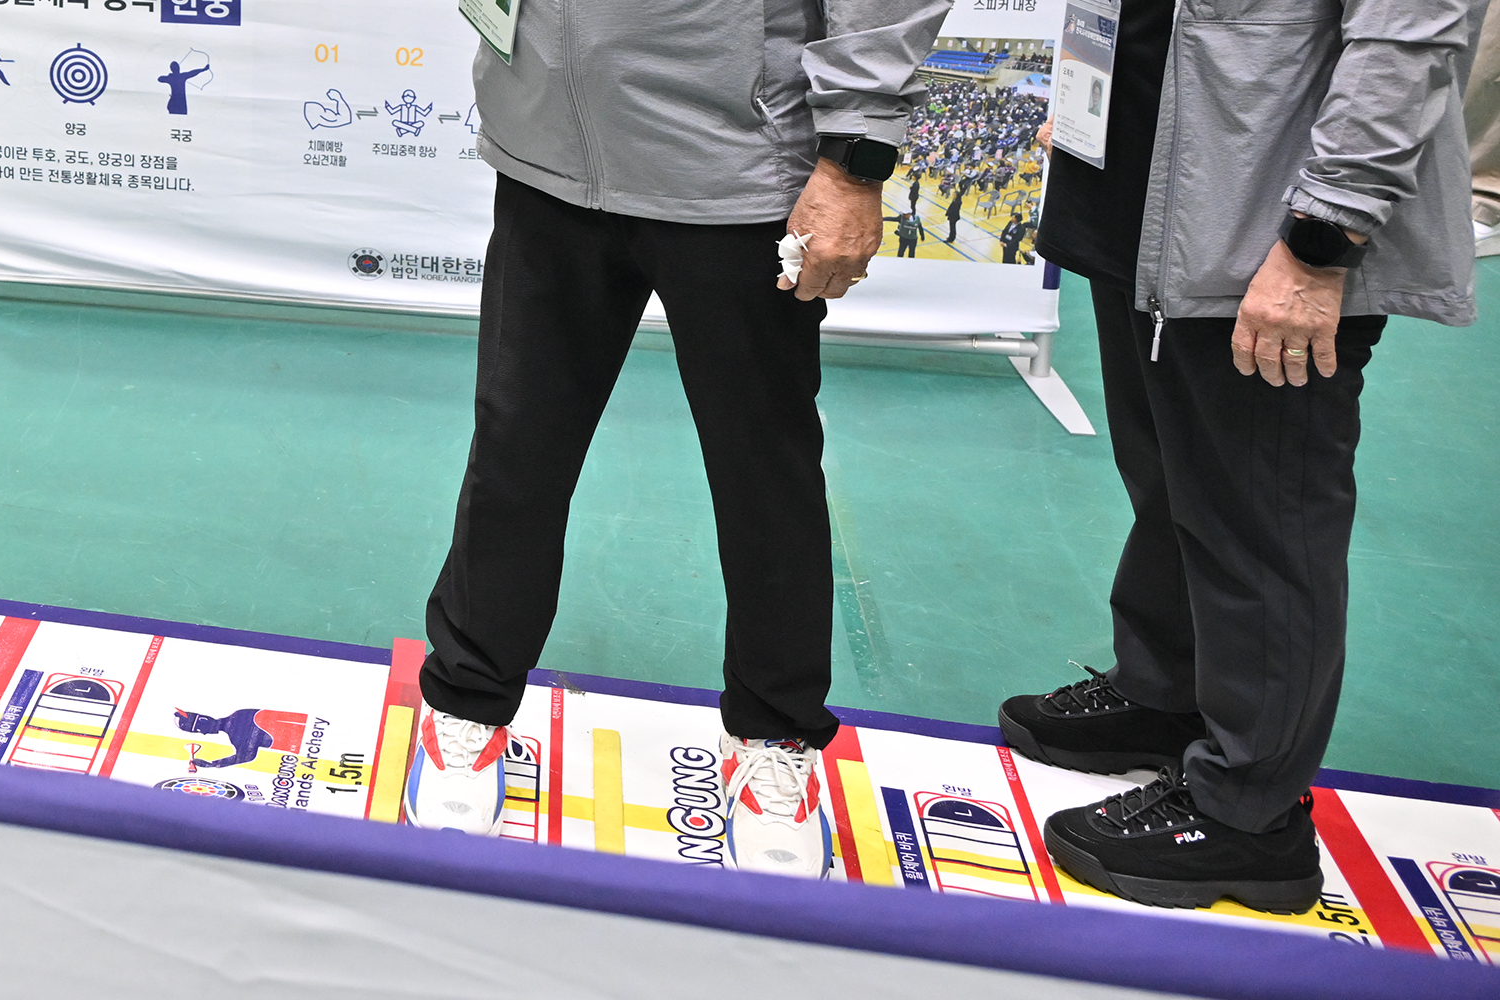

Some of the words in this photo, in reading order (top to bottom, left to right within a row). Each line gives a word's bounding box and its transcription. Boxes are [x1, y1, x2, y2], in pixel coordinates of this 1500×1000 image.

[314, 43, 339, 63] 01
[395, 46, 424, 67] 02
[65, 122, 86, 136] 양궁
[170, 128, 192, 143] 국궁
[308, 139, 343, 153] 치매예방
[372, 143, 416, 157] 주의집중력
[419, 145, 437, 158] 향상
[32, 147, 61, 163] 투호,
[64, 149, 93, 165] 궁도,
[98, 152, 135, 168] 양궁의
[139, 154, 178, 171] 장점을
[303, 153, 347, 168] 오십견재활
[19, 166, 44, 182] 만든
[48, 168, 123, 188] 전통생활체육
[127, 174, 195, 192] 종목입니다.
[390, 254, 419, 267] 사단
[391, 266, 418, 280] 법인
[421, 273, 448, 282] KOREA
[301, 717, 330, 770] Archery
[326, 752, 365, 794] 1.5m
[941, 783, 974, 798] 왼발
[895, 831, 915, 853] 바퀴
[1174, 830, 1206, 845] FILA
[1451, 851, 1487, 866] 왼발
[900, 852, 924, 881] 휠체어
[1422, 905, 1444, 925] 바퀴
